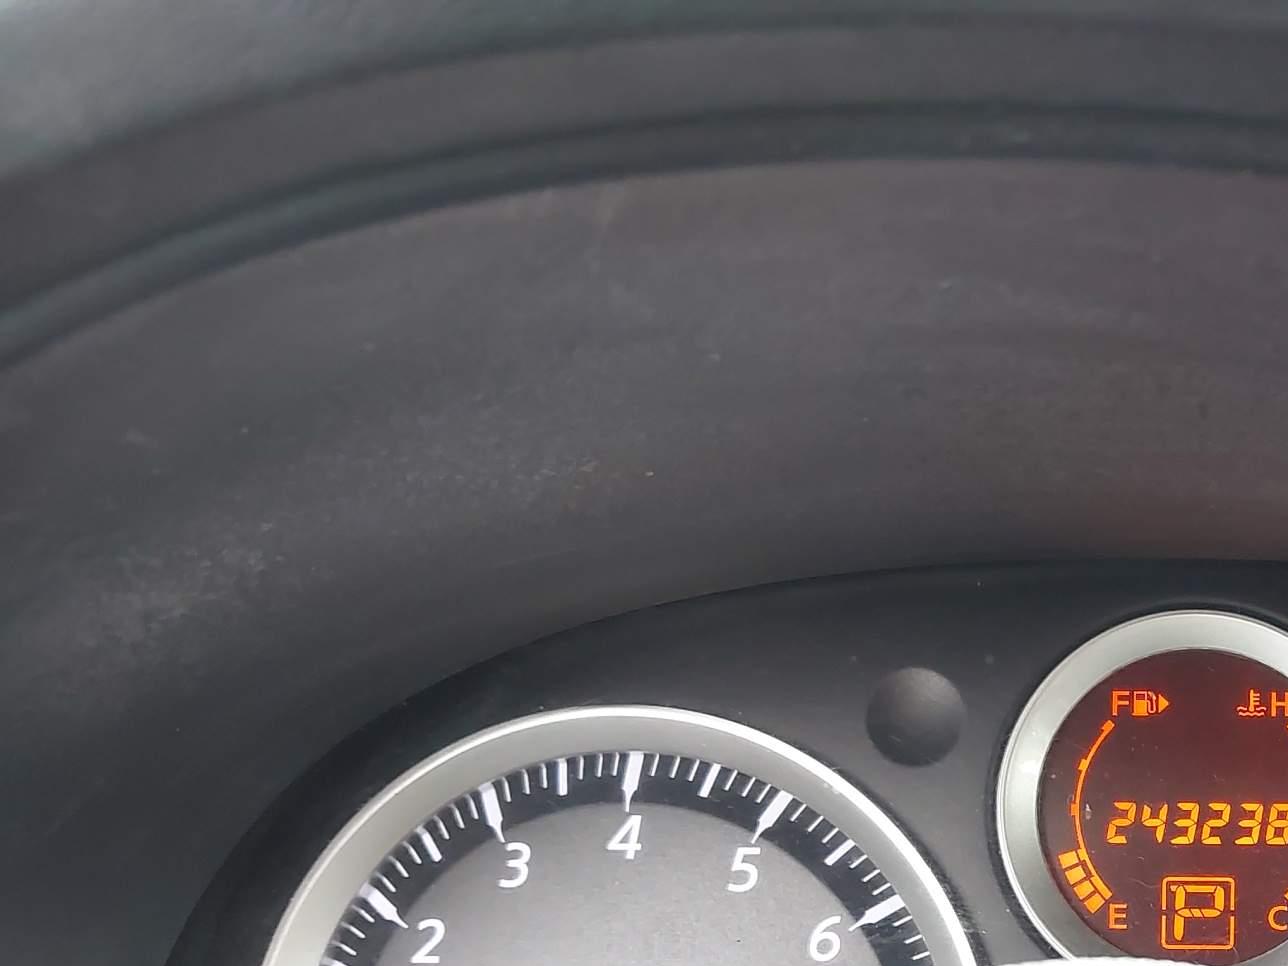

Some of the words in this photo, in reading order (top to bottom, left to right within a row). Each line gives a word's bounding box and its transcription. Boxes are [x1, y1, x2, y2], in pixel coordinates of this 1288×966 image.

[1112, 690, 1130, 717] F
[608, 815, 643, 860] 4
[499, 843, 532, 889] 3
[727, 846, 761, 893] 5
[1107, 904, 1129, 930] E
[1170, 884, 1223, 942] P
[410, 918, 445, 965] 2
[809, 915, 842, 962] 6
